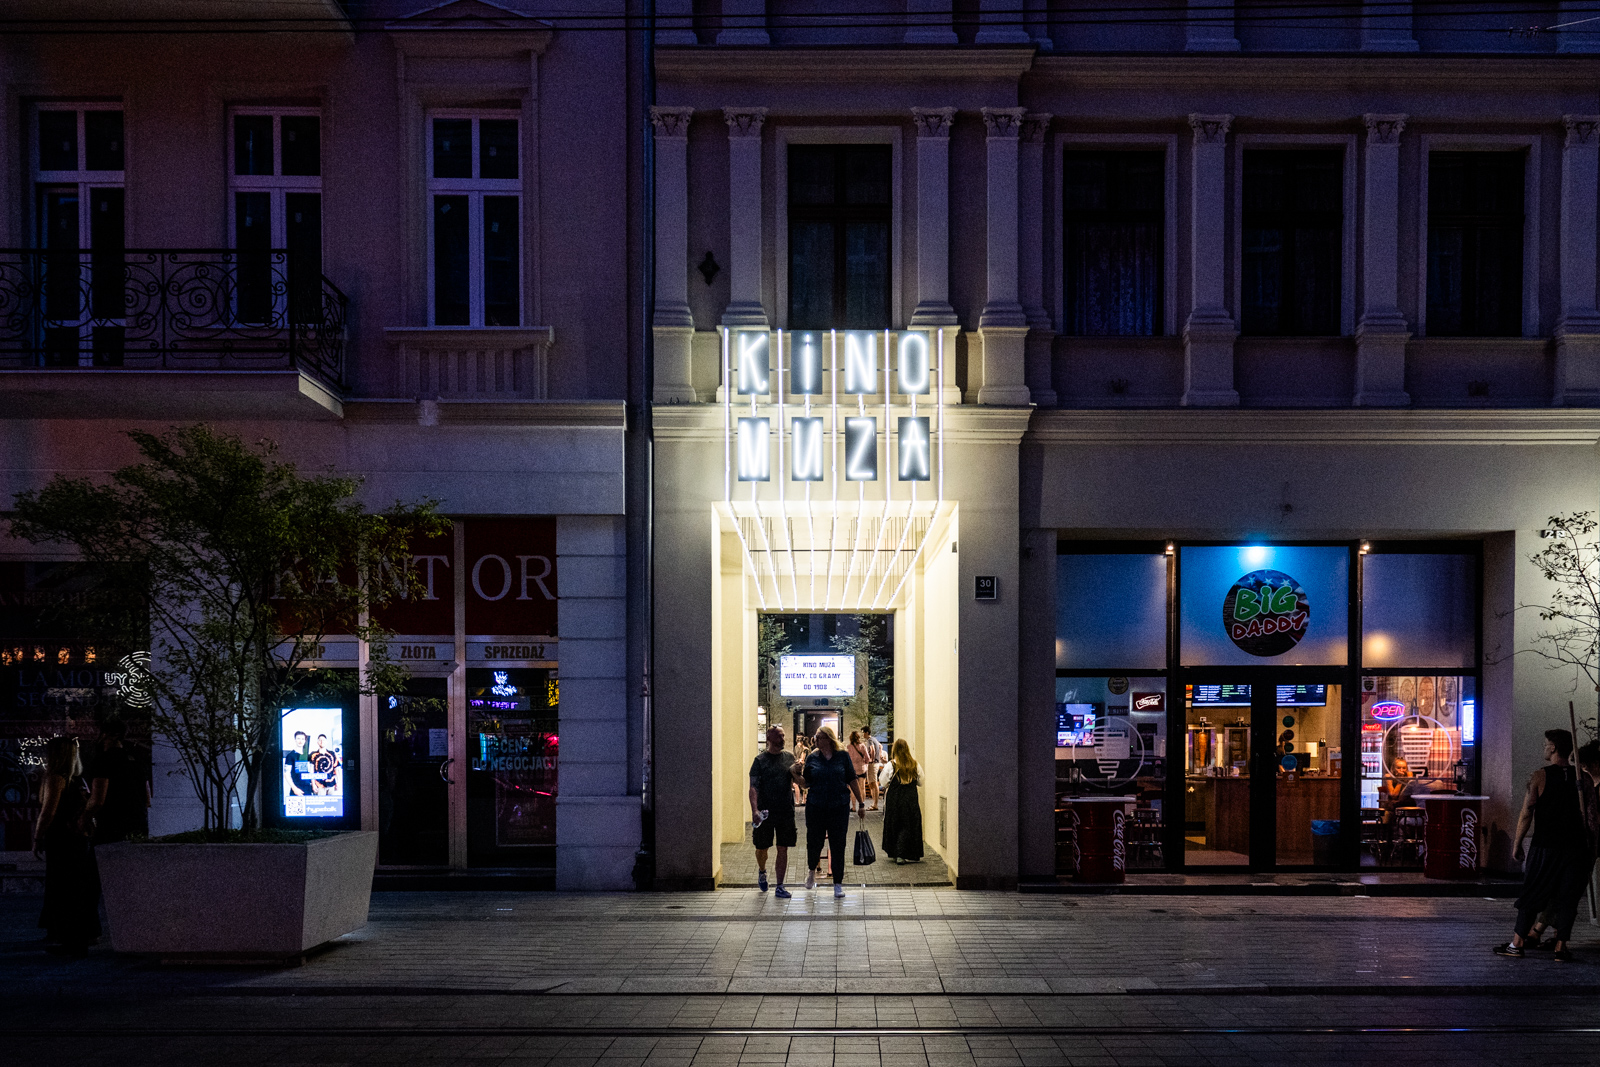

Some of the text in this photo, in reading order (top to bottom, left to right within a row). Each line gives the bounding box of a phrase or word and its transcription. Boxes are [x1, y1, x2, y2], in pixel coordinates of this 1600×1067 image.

[740, 420, 927, 478] MUZA
[979, 578, 992, 588] 30
[1232, 611, 1307, 640] DADDY
[401, 645, 436, 659] ZŁOTA
[484, 643, 545, 659] SPRZEDAŻ
[1370, 705, 1406, 717] OPEN
